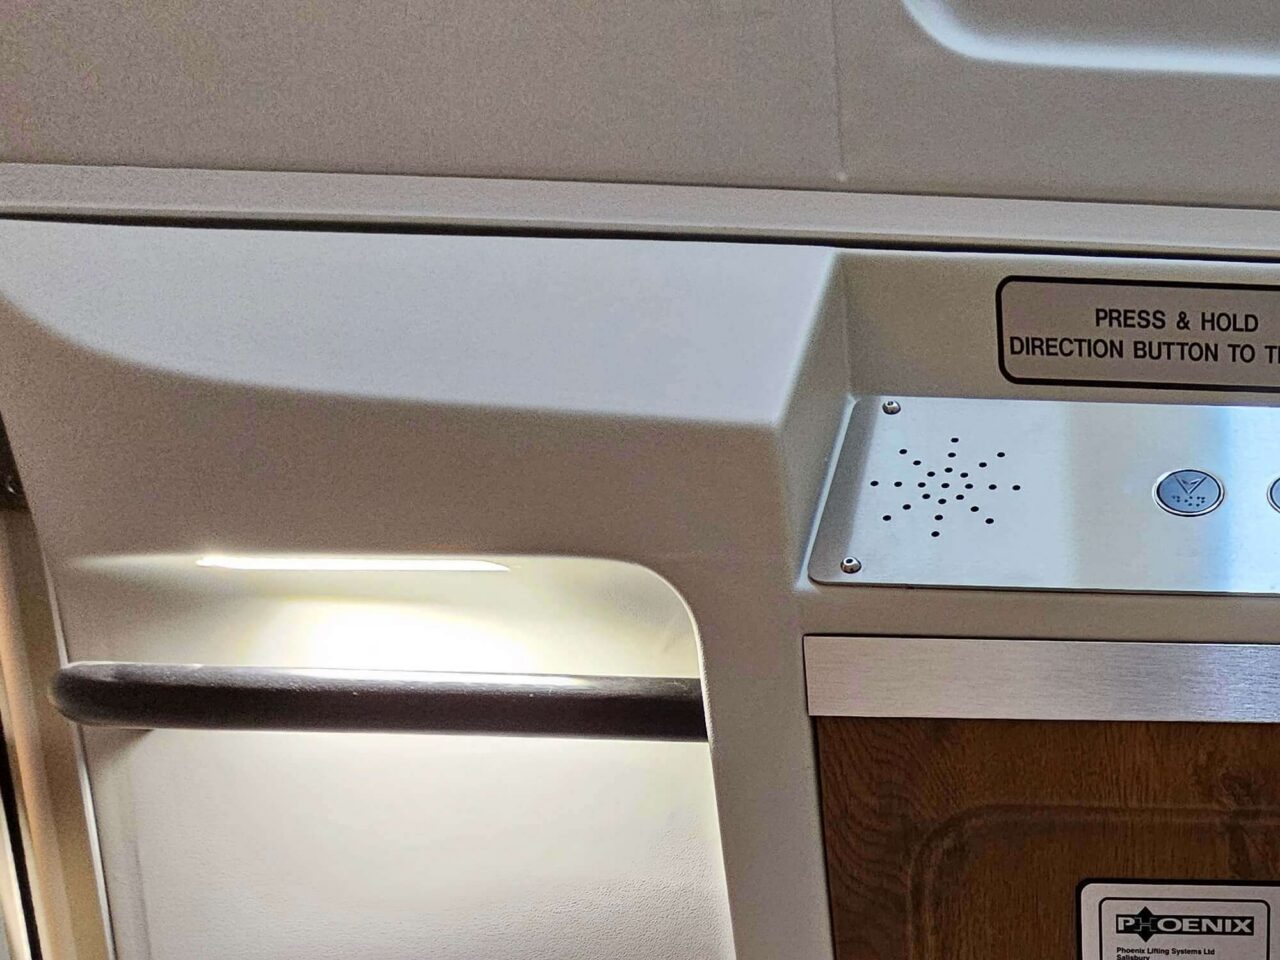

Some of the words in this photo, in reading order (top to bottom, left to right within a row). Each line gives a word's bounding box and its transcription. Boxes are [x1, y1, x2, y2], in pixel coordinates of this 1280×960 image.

[1095, 308, 1166, 329] PRESS
[1176, 311, 1191, 330] &
[1201, 312, 1258, 332] HOLD
[1009, 337, 1124, 359] DIRECTION
[1133, 341, 1219, 362] BUTTON
[1227, 344, 1255, 363] TO
[1117, 916, 1252, 933] PHOENIX
[1147, 947, 1170, 955] Lifting
[1171, 948, 1202, 956] Systems
